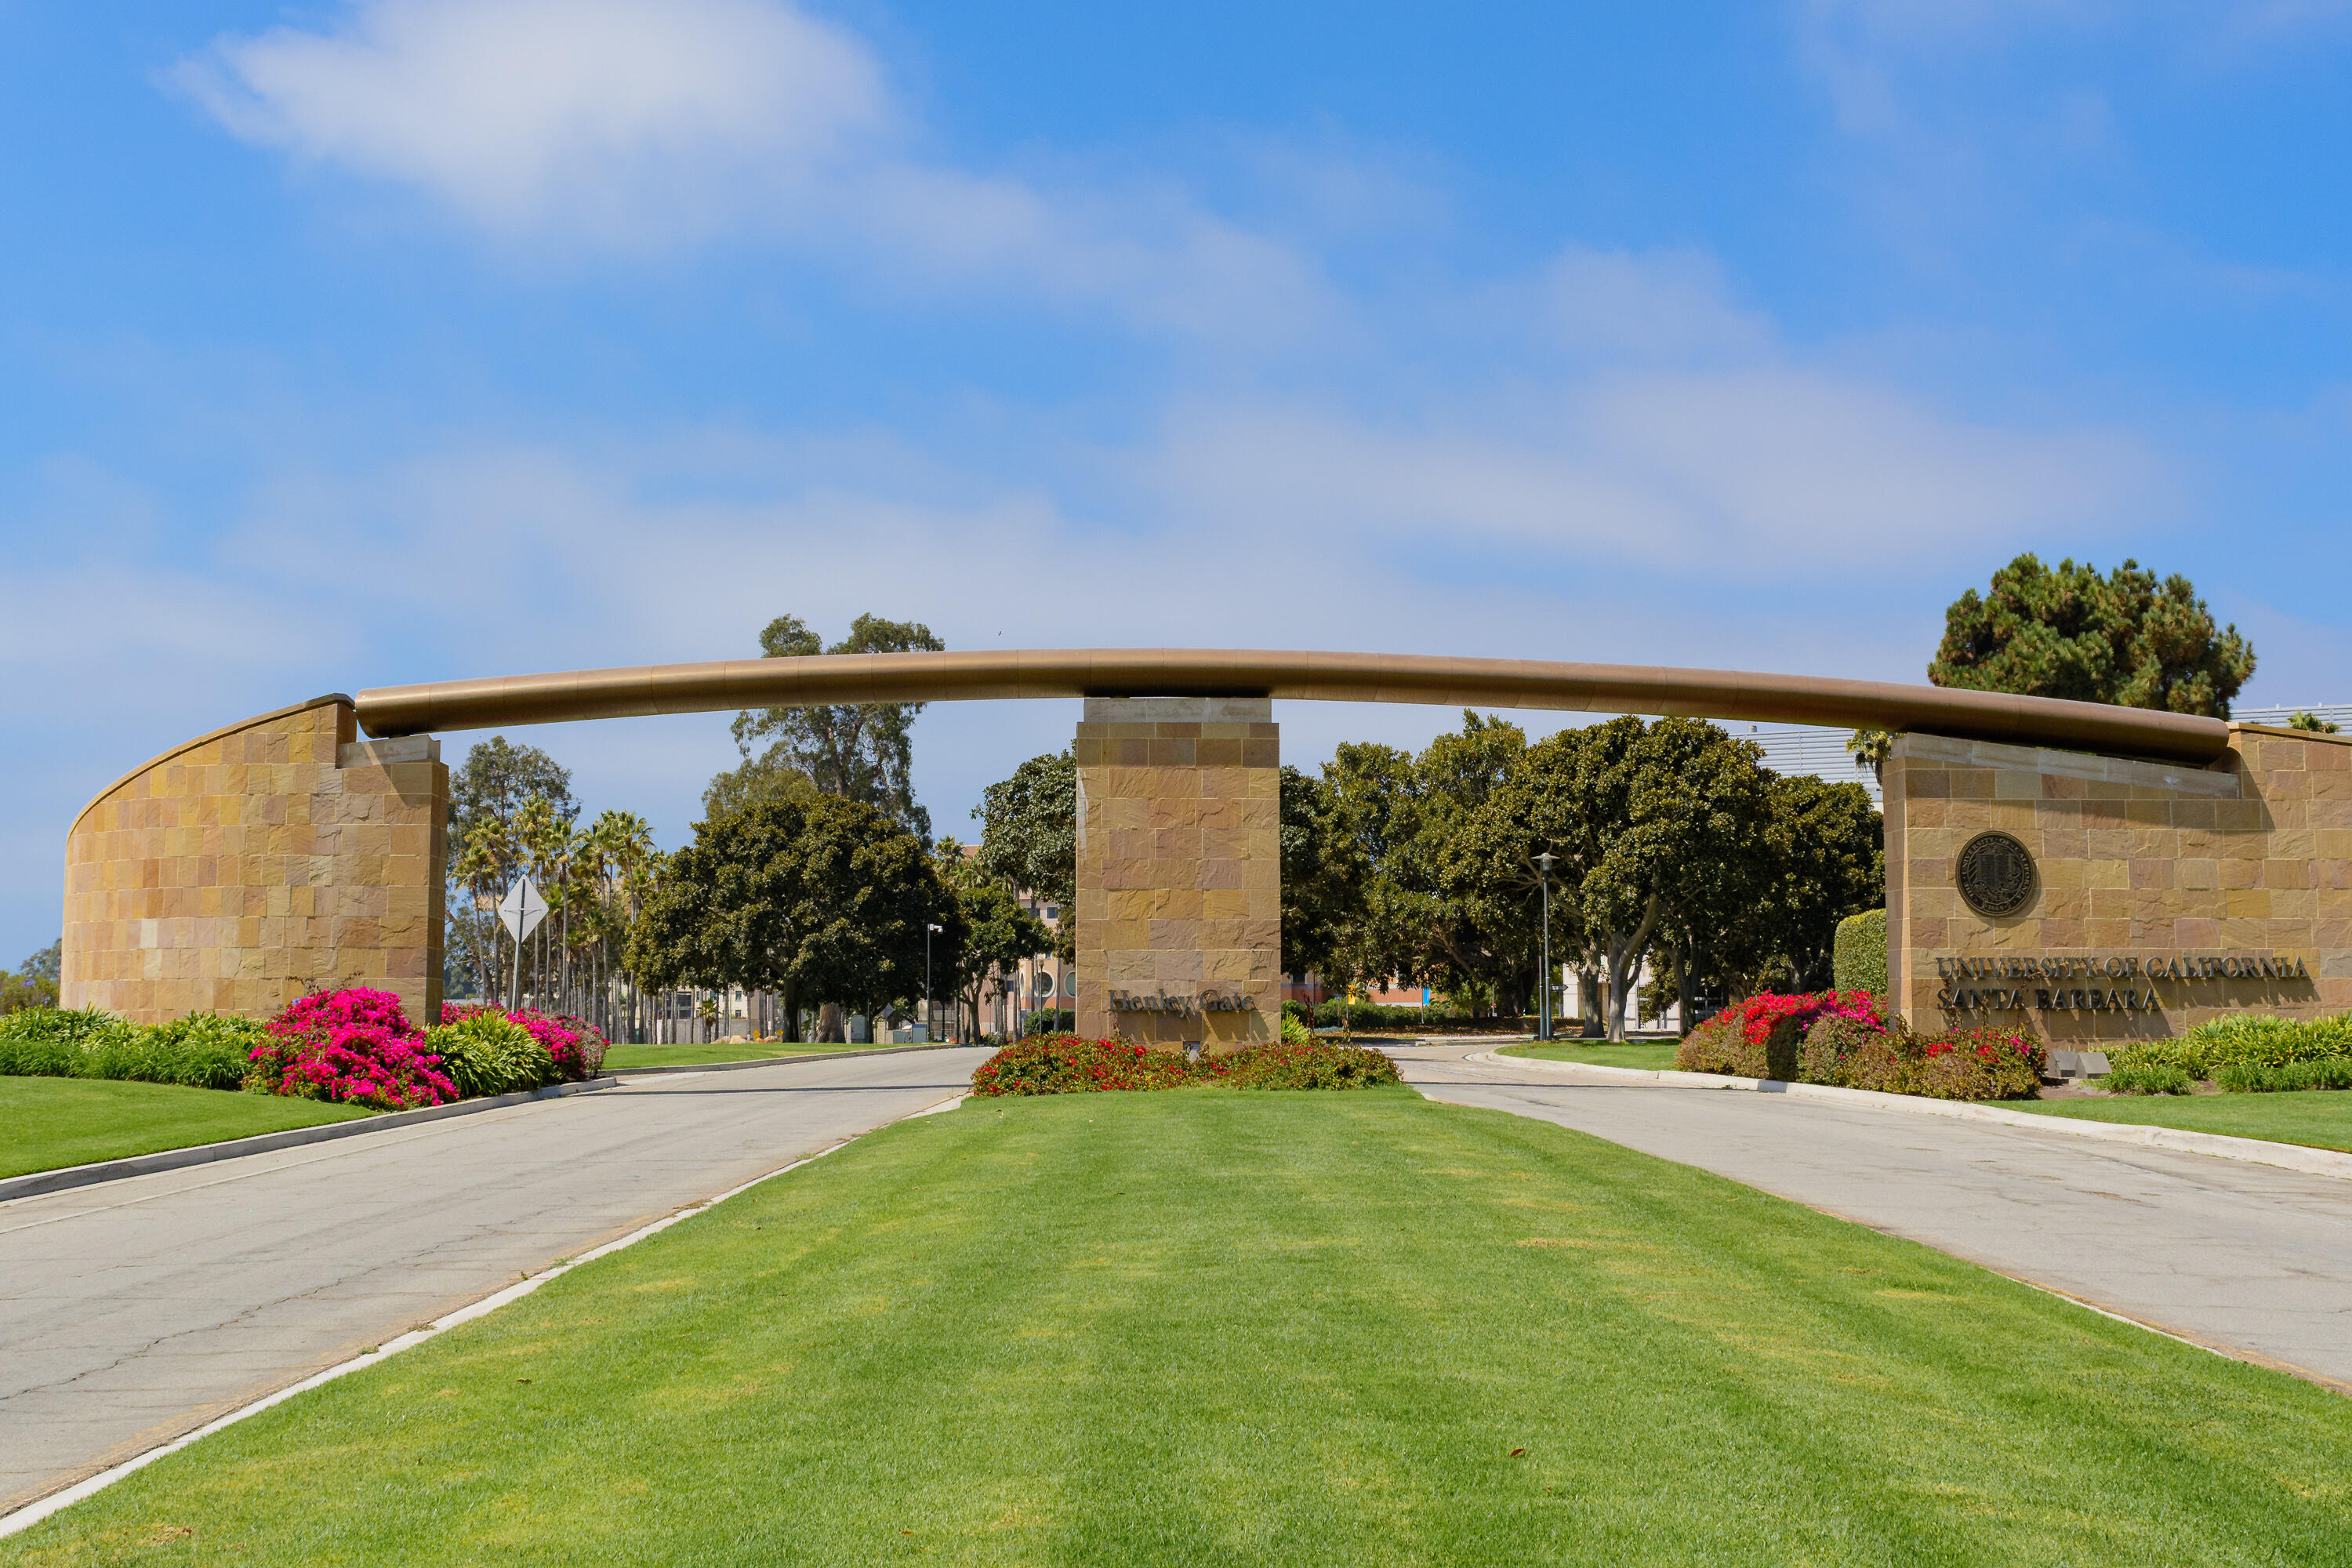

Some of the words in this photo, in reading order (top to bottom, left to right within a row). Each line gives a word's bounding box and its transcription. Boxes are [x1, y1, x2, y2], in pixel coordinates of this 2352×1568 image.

[1962, 837, 1994, 874] UNIVERSITY
[1936, 956, 2099, 978] UNIVERSITY
[2104, 956, 2138, 978] OF
[2145, 956, 2309, 978] CALIFORNIA
[1108, 989, 1192, 1018] Henley
[1199, 989, 1255, 1011] Gate
[1936, 988, 2020, 1010] SANTA
[2035, 988, 2158, 1011] BARBARA
